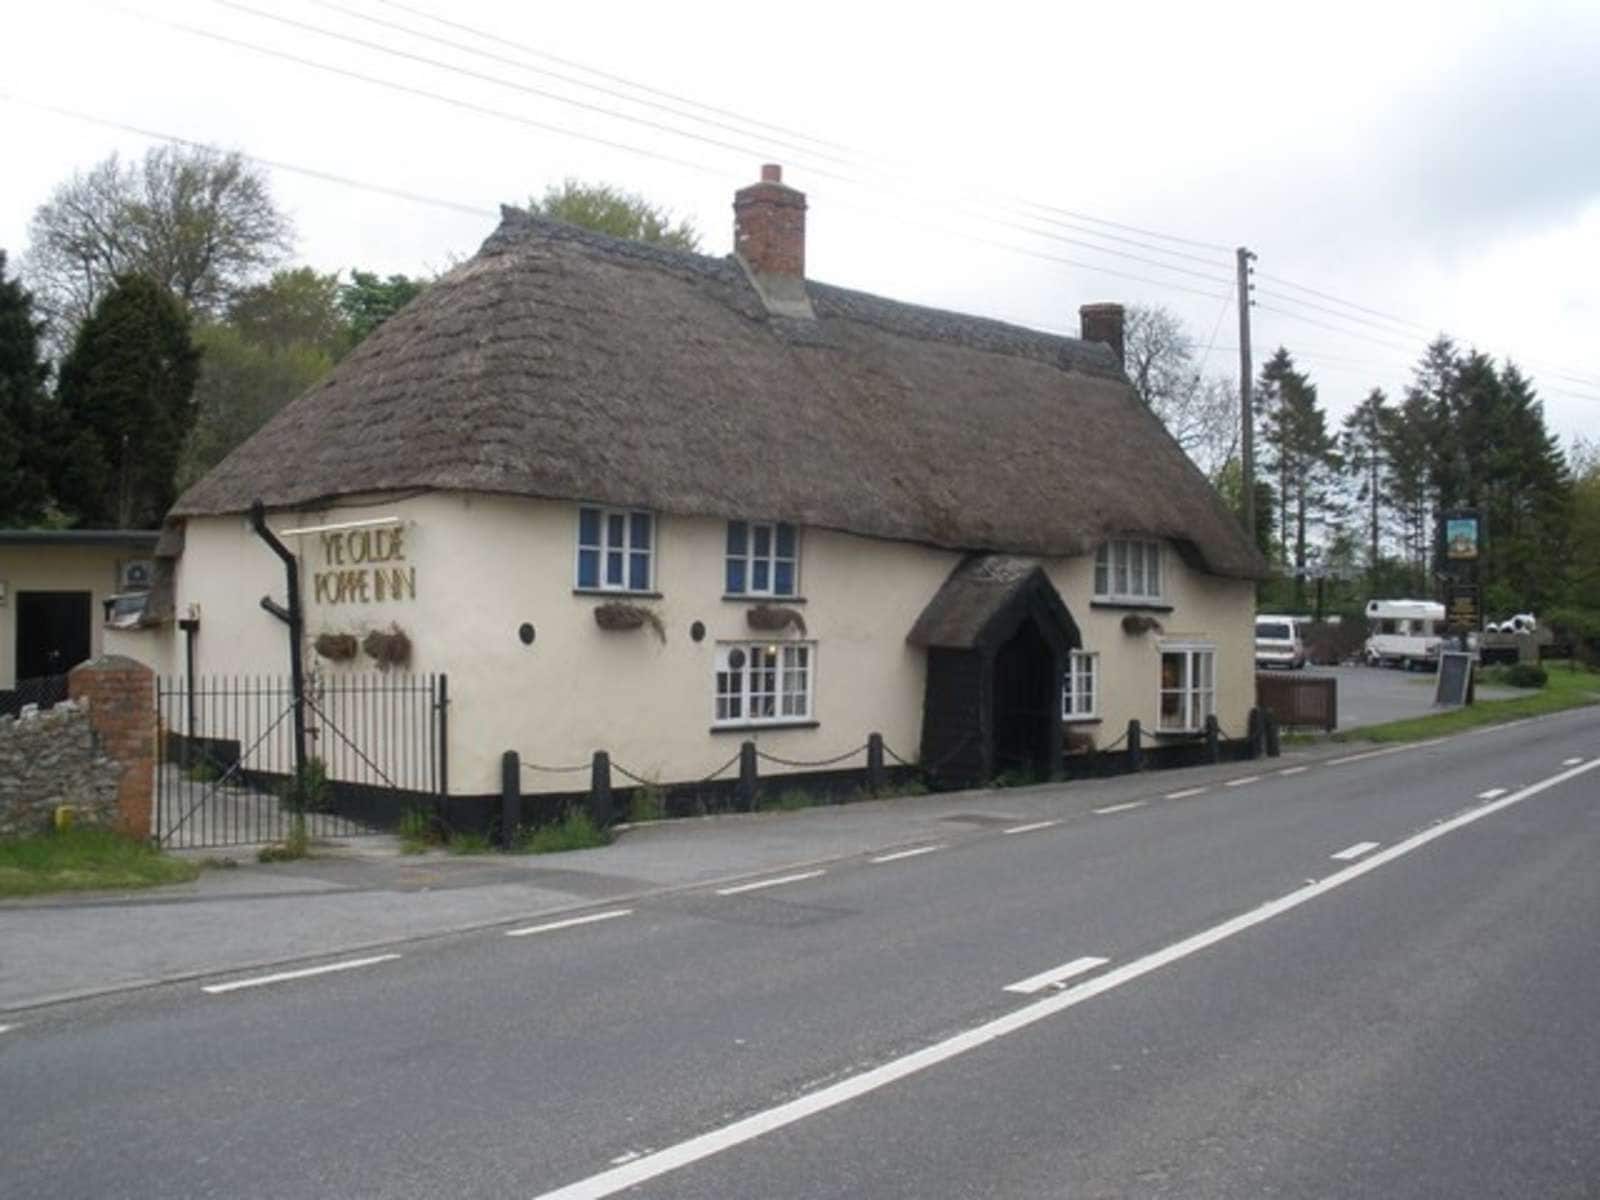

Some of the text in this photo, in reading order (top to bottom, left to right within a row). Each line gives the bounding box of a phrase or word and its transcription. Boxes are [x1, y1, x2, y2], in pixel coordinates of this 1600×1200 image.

[320, 527, 405, 565] YE OLDE
[374, 566, 416, 602] INN
